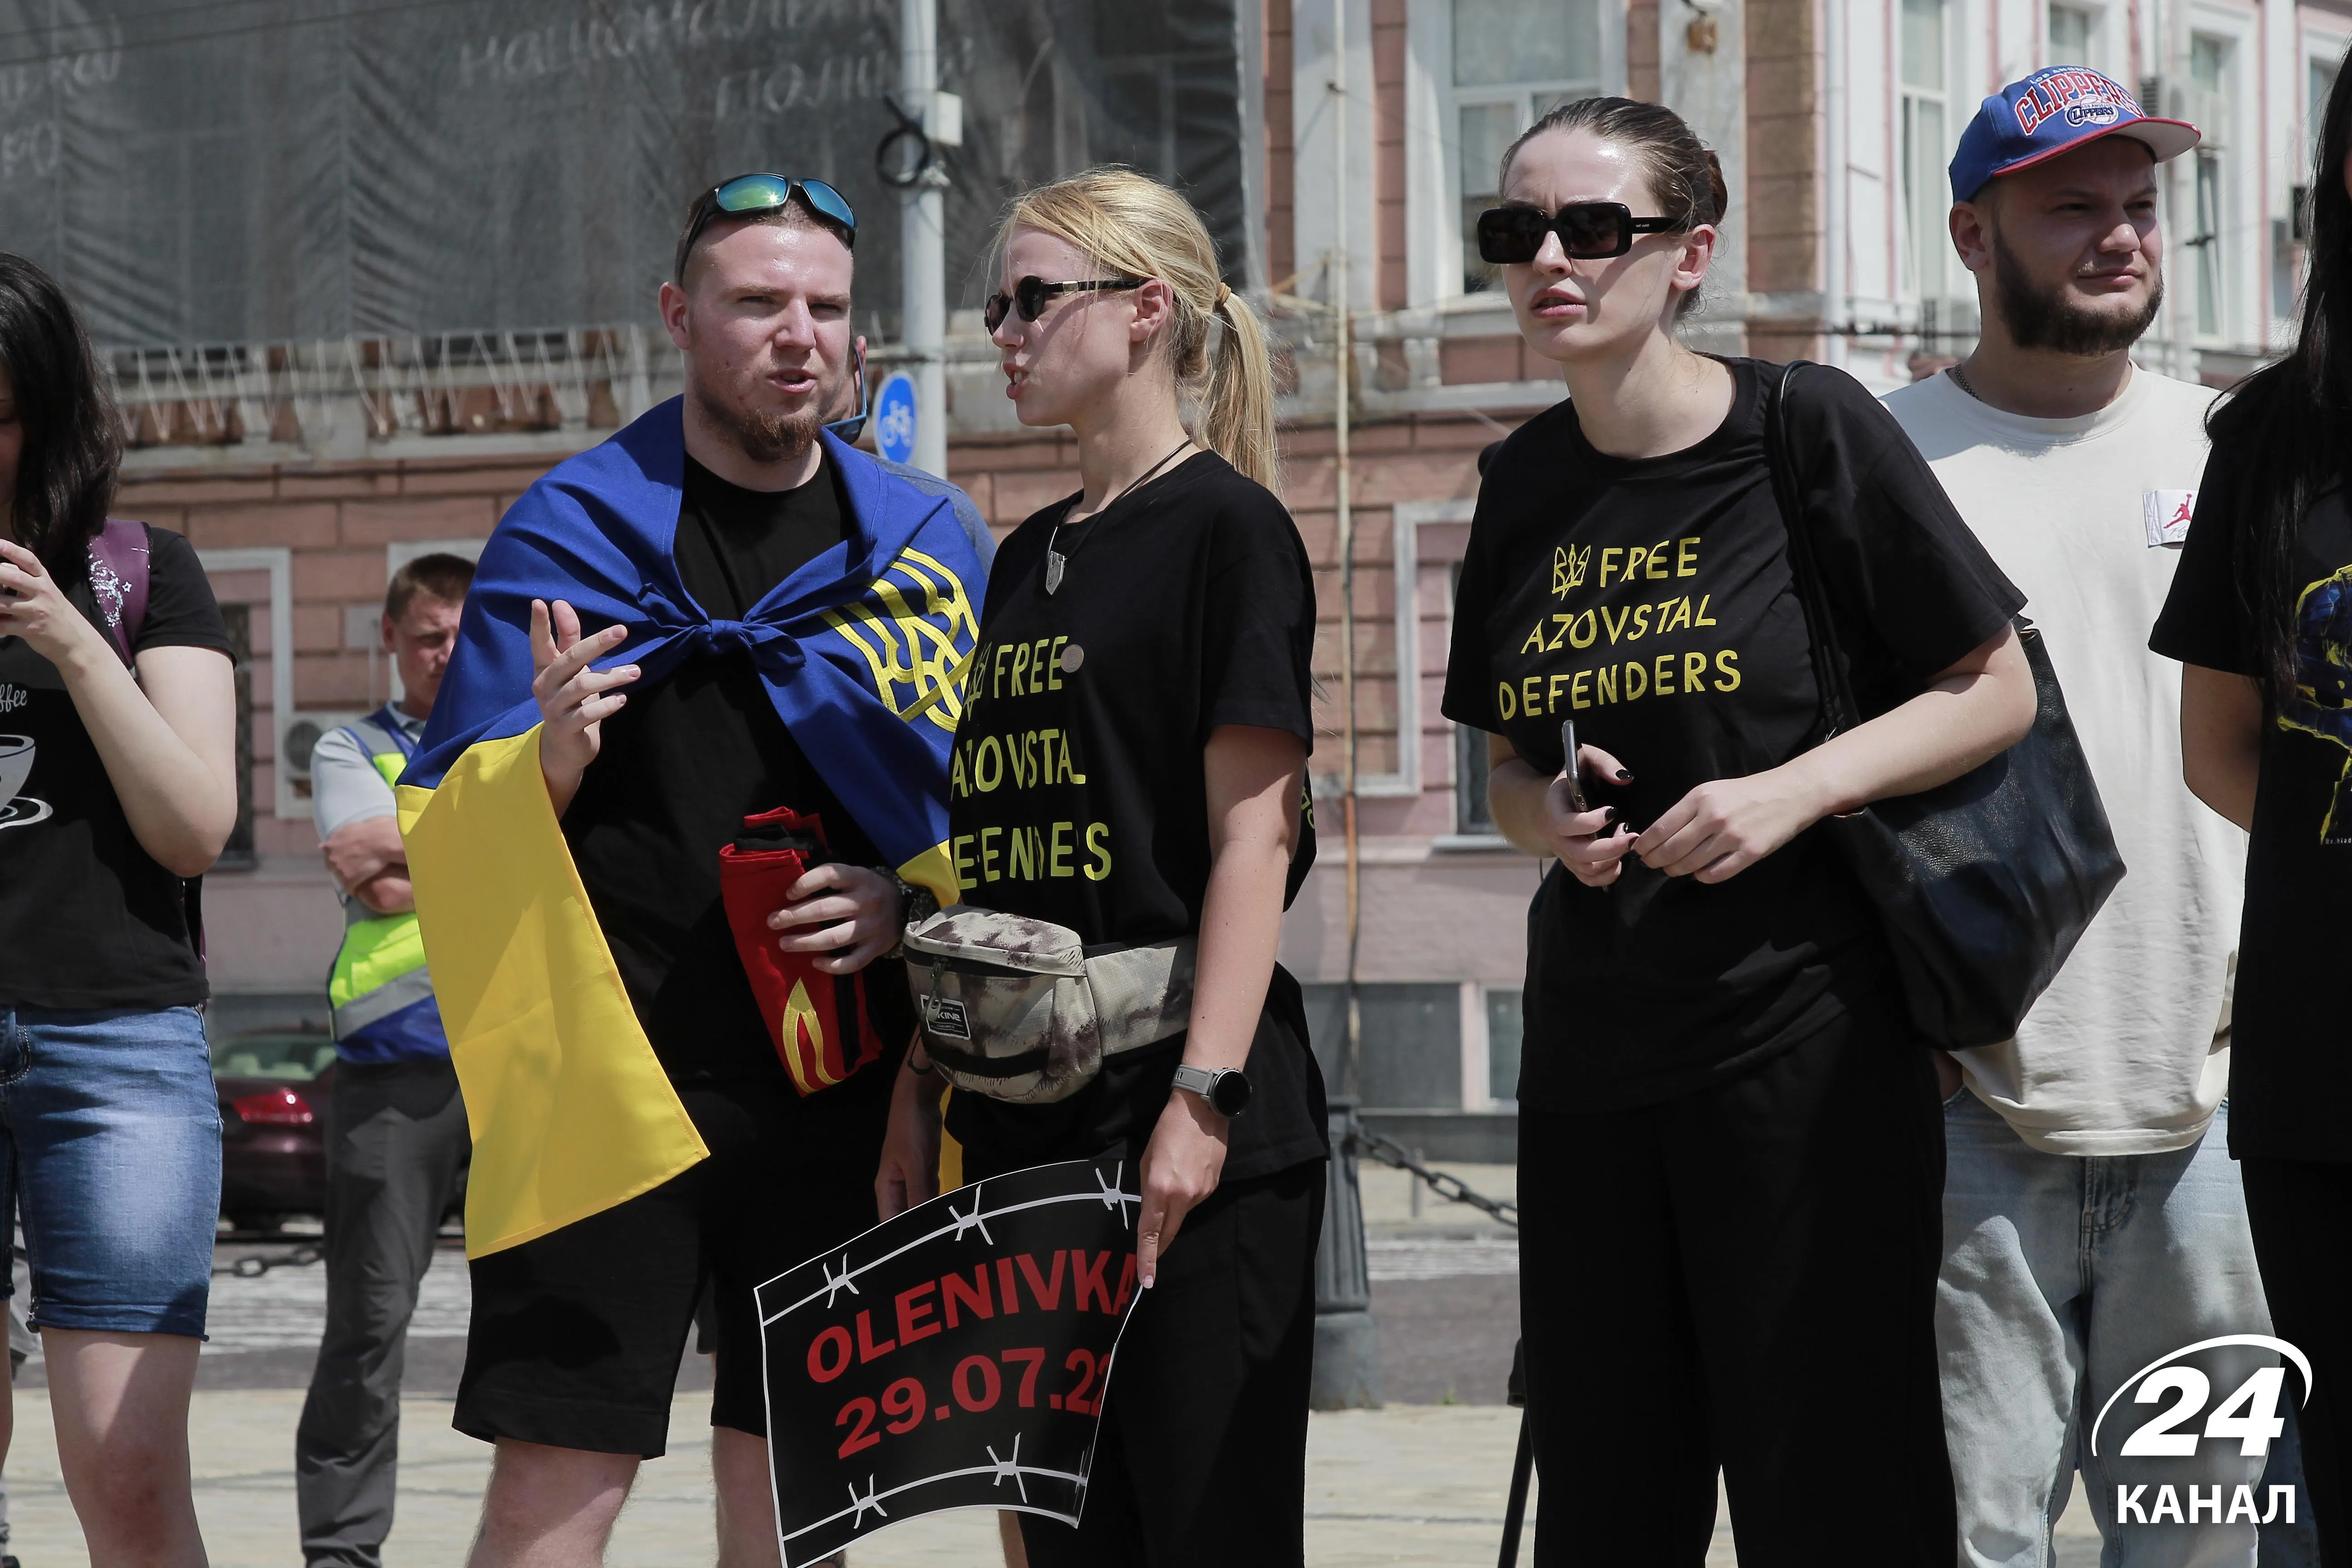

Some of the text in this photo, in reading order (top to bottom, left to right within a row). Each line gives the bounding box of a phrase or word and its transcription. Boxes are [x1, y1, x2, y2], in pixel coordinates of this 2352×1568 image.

[2014, 71, 2146, 137] CLIPPERS
[2067, 106, 2114, 125] CLIPPERS
[1600, 537, 1700, 588] FREE
[1520, 594, 1717, 654] AZOVSTAL
[994, 636, 1068, 699] FREE
[1499, 650, 1741, 720] DEFENDERS
[806, 1249, 1137, 1383] OLENIVKA
